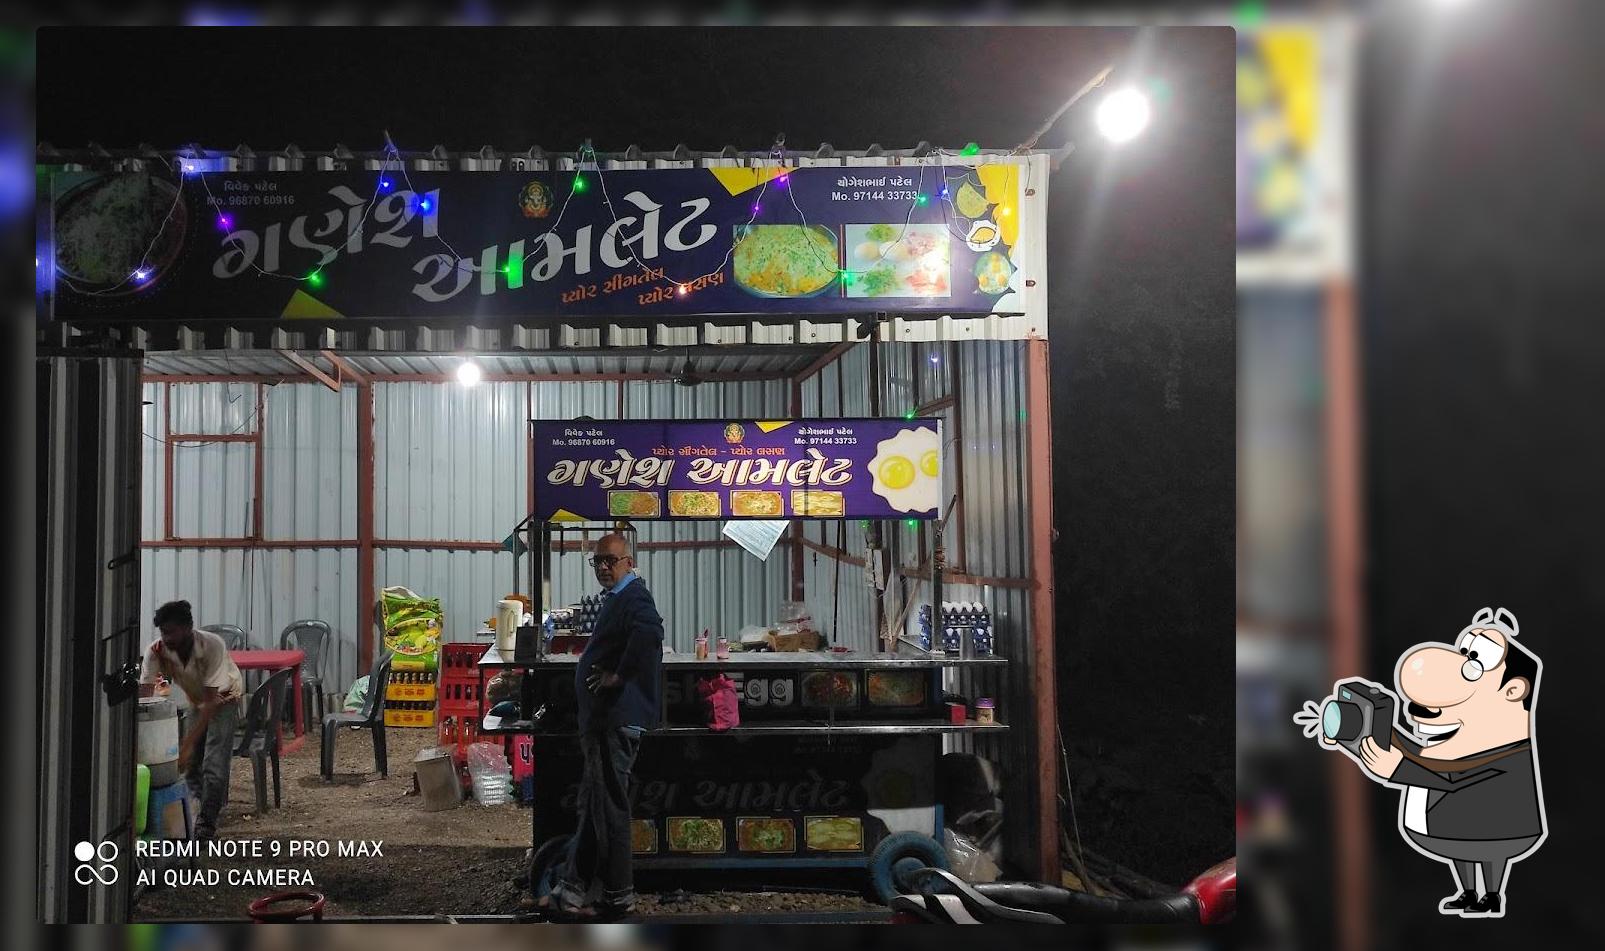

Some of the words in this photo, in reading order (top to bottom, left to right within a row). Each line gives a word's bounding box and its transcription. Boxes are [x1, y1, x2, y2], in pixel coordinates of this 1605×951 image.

[889, 175, 912, 187] પટેલ
[206, 195, 226, 206] Mo.
[229, 195, 260, 206] 96870
[263, 195, 295, 205] 60916
[831, 192, 851, 201] Mo.
[853, 191, 884, 201] 97144
[887, 191, 918, 200] 33733
[212, 185, 441, 280] ગણેશ
[411, 190, 718, 303] આમલેટ
[560, 284, 598, 304] પ્યોર
[637, 286, 674, 306] પ્યોર
[552, 438, 567, 446] Mo.
[568, 438, 591, 446] 96870
[592, 438, 616, 446] 60916
[794, 437, 809, 445] Mo.
[810, 437, 833, 445] 97144
[834, 437, 857, 445] 33733
[651, 445, 675, 456] પ્યોર
[729, 445, 753, 456] પ્યોર
[756, 447, 785, 456] લસણ
[547, 448, 675, 489] ગણેશ
[686, 447, 853, 488] આમલેટ
